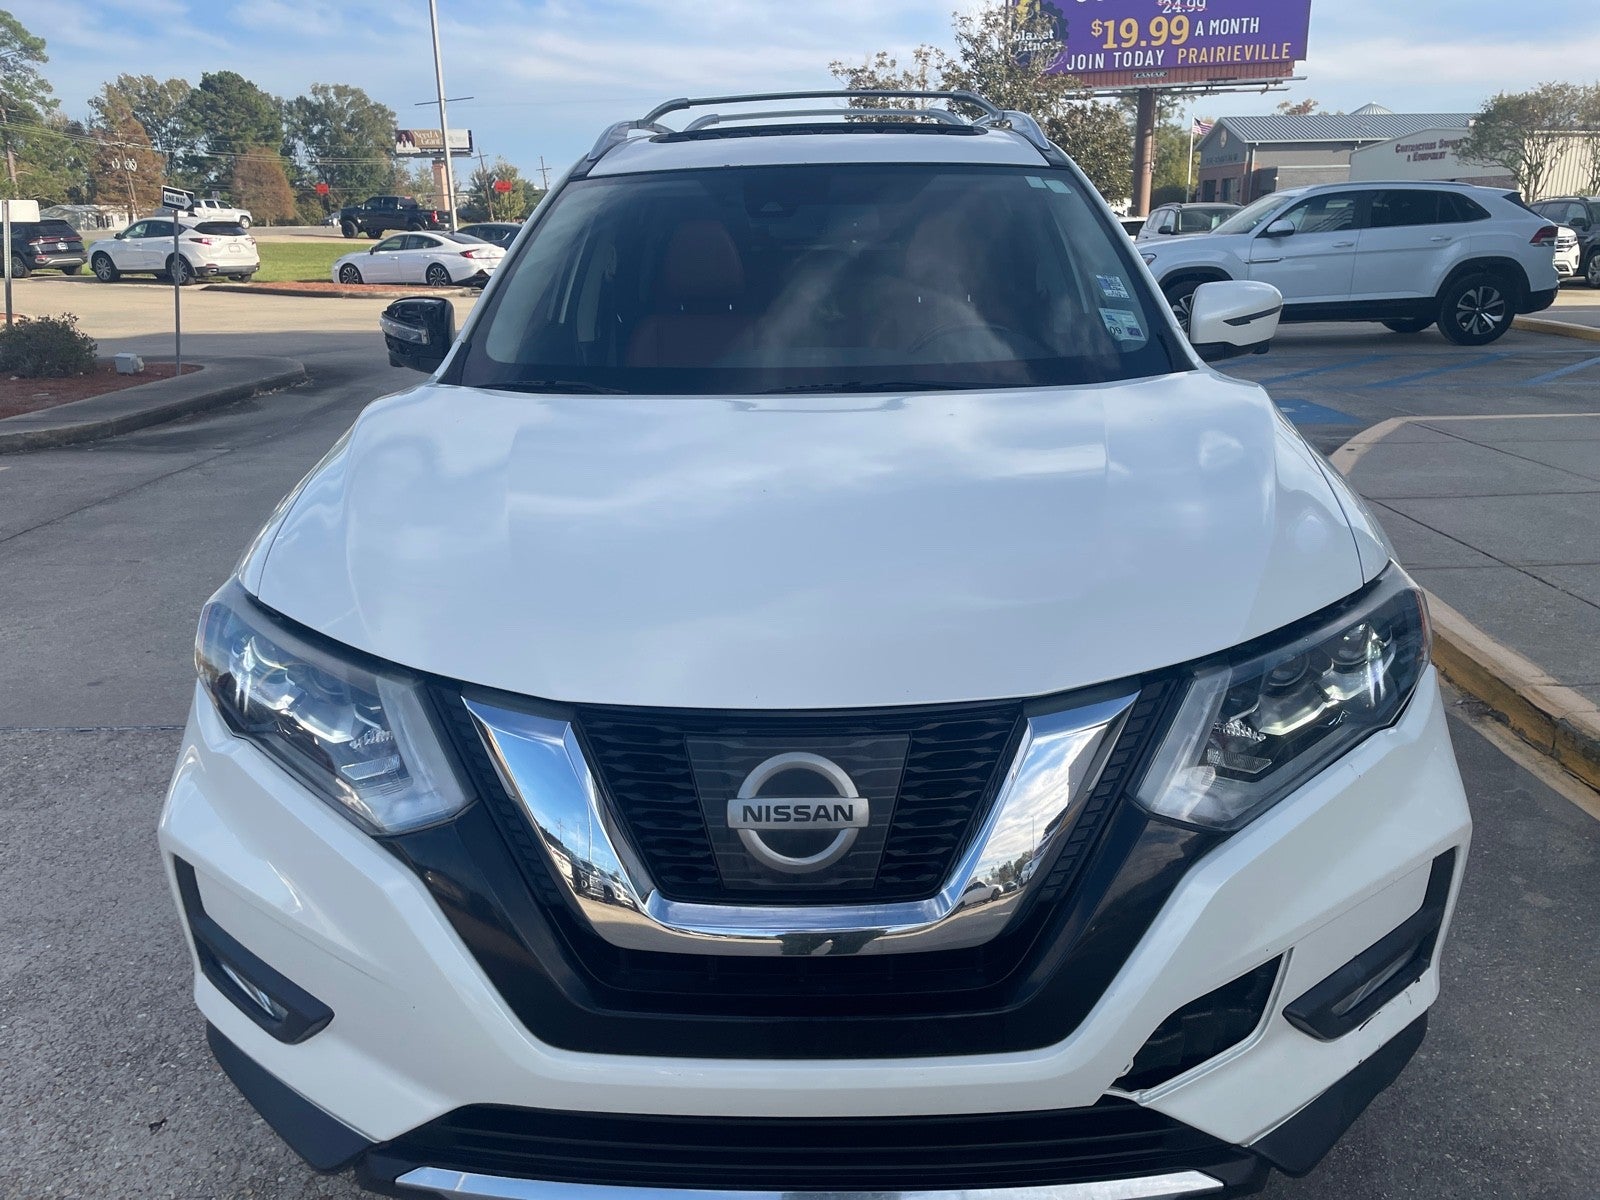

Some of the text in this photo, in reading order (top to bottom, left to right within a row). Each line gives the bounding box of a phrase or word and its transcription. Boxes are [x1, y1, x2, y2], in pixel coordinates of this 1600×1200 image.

[1091, 15, 1260, 49] $19.99 A MONTH
[1066, 42, 1292, 71] JOIN TODAY PRAIRIEVILLE
[742, 804, 854, 822] NISSAN
